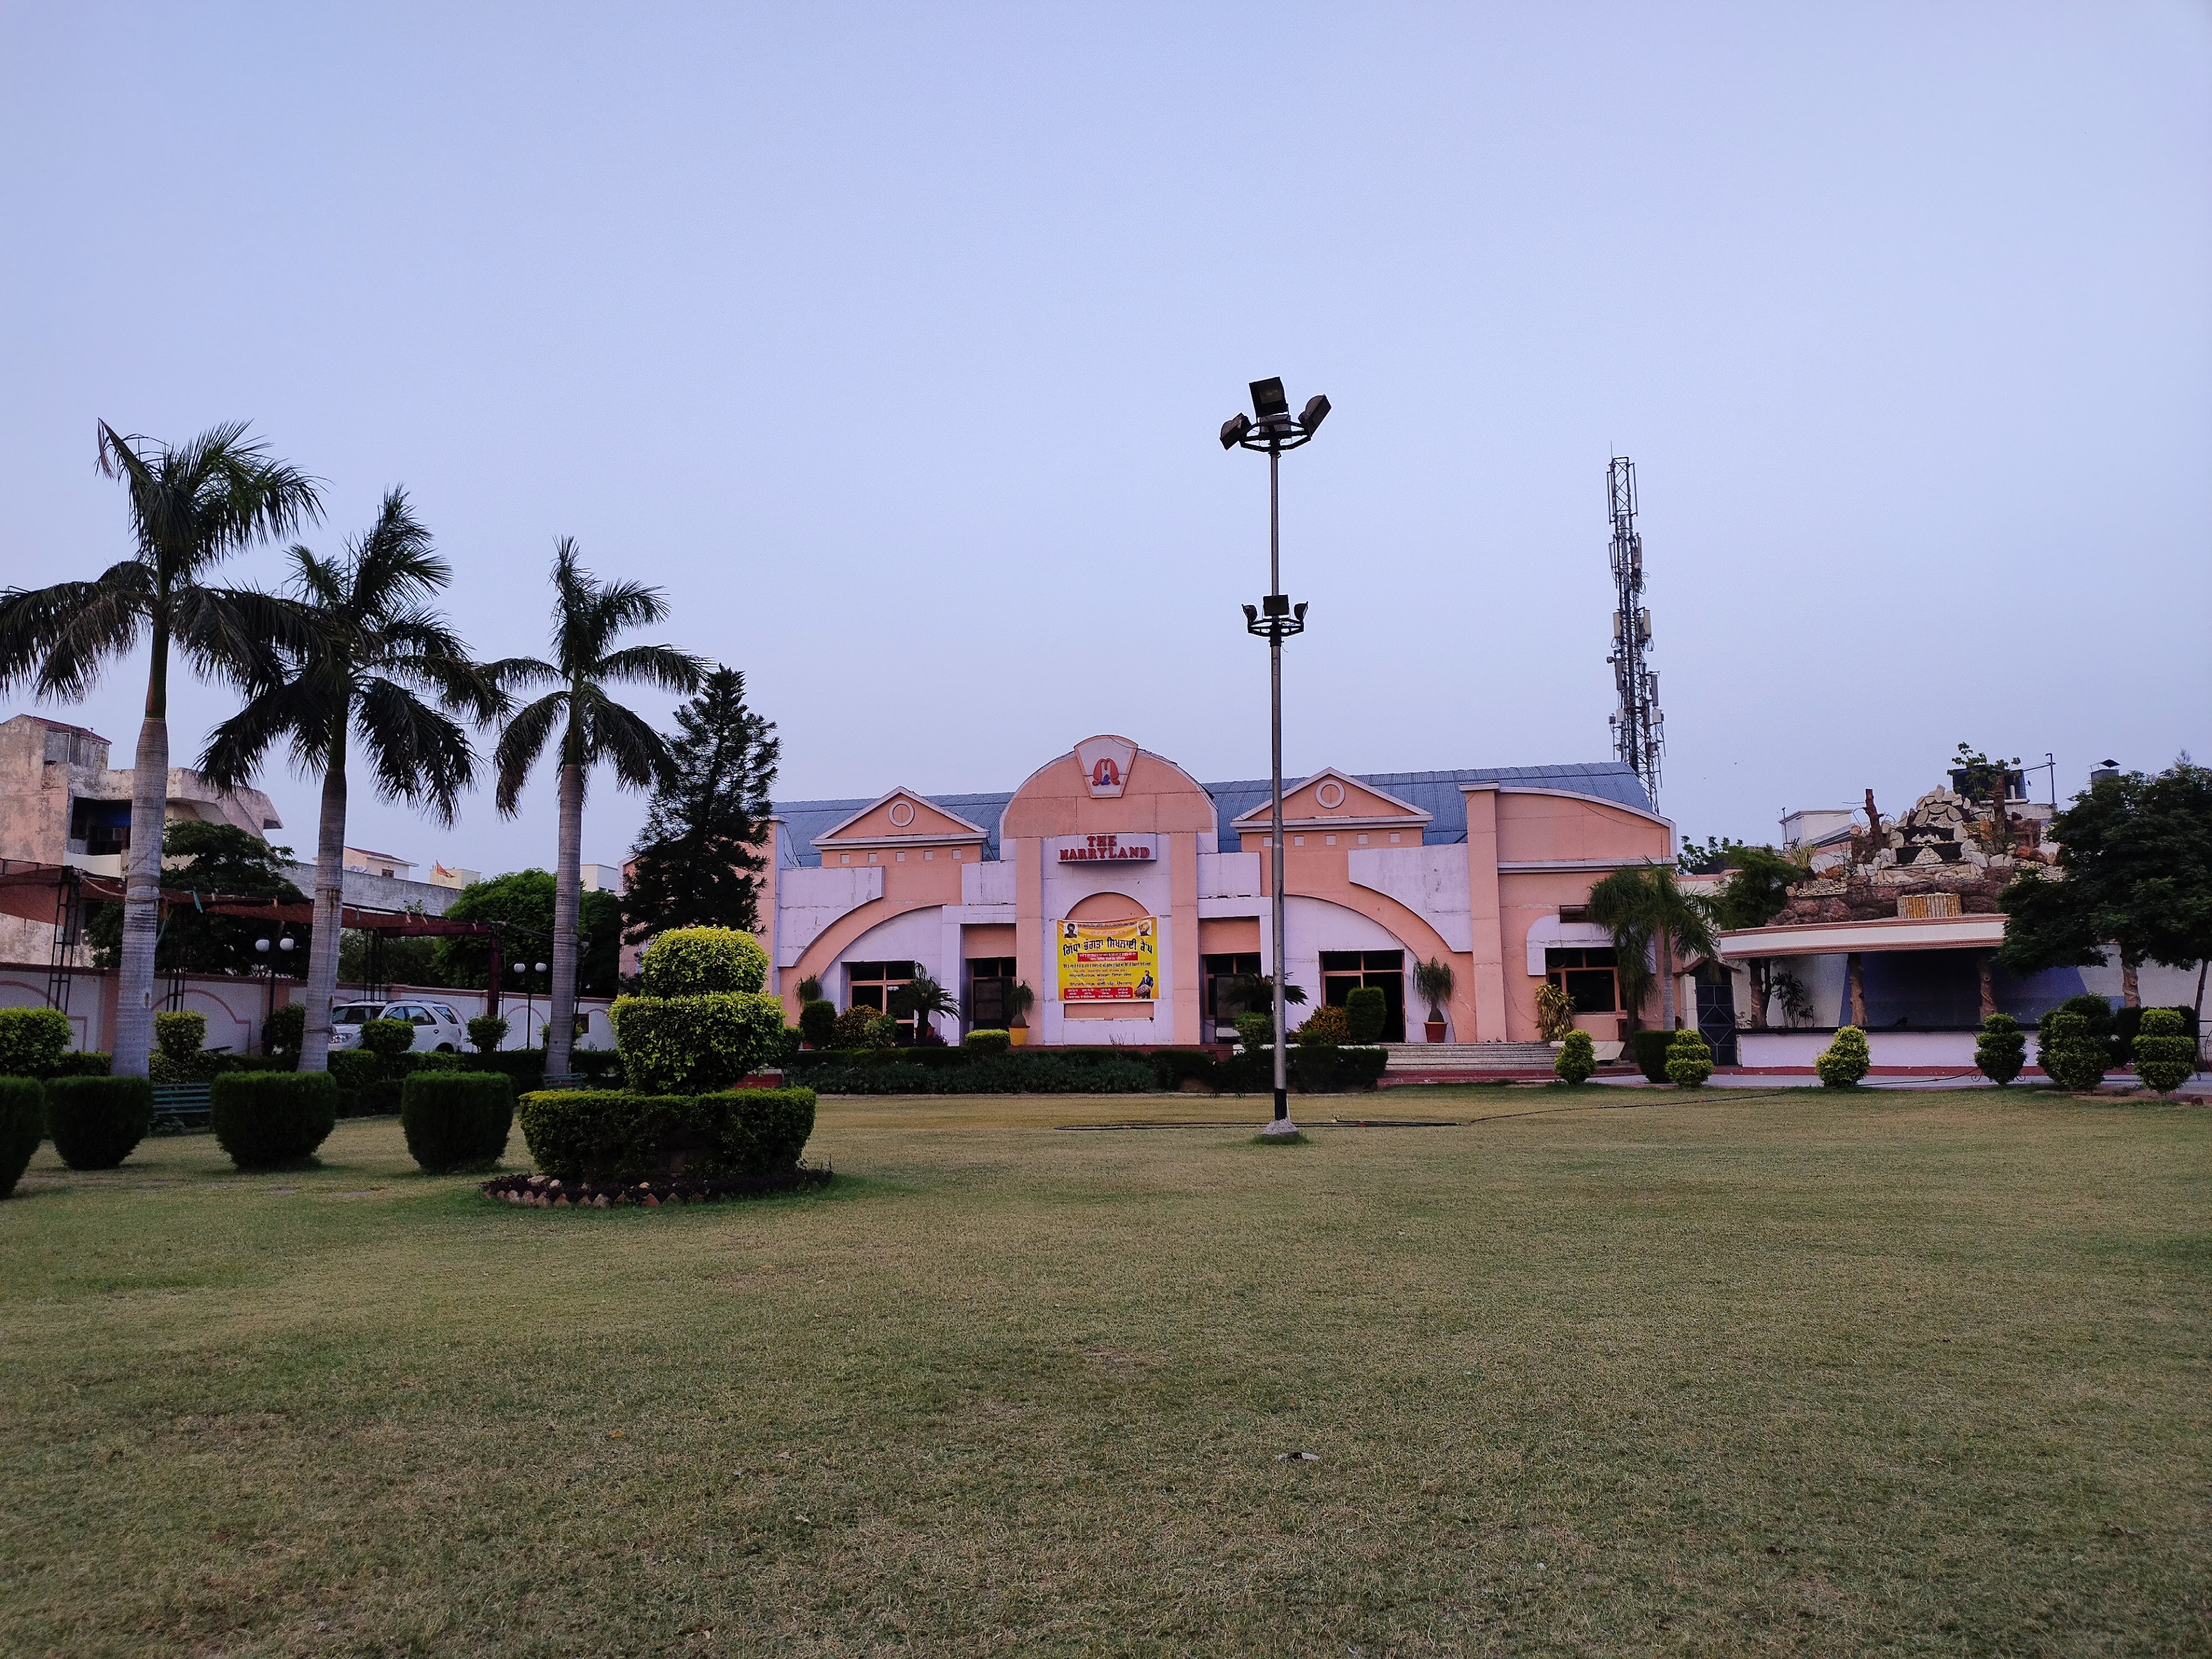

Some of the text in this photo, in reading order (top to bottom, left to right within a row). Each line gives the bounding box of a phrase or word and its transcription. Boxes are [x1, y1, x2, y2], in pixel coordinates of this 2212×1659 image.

[1087, 835, 1117, 847] THE
[1059, 847, 1150, 860] MARRYLAND
[1084, 939, 1104, 950] ਭੰਗੜਾ
